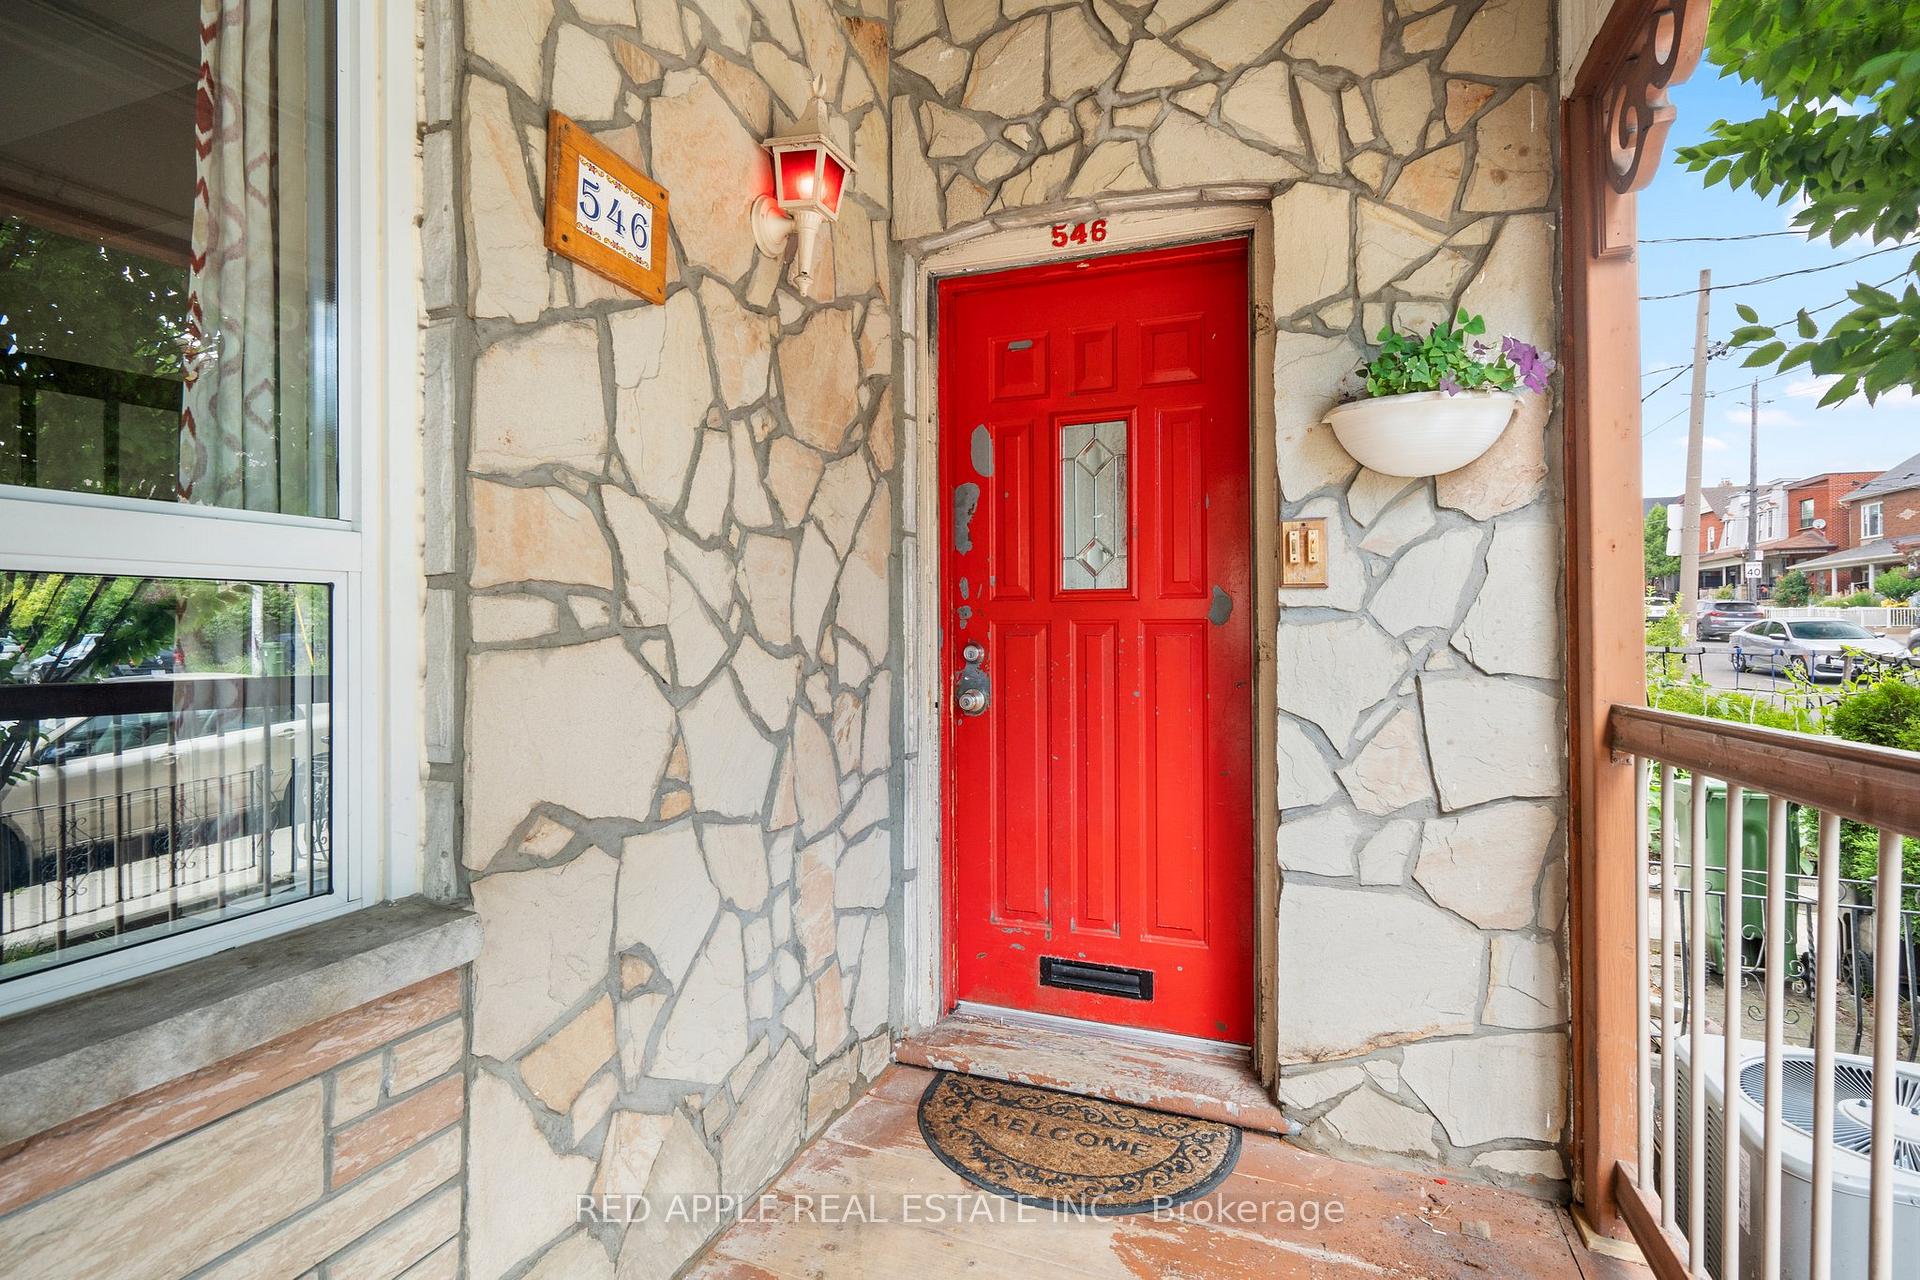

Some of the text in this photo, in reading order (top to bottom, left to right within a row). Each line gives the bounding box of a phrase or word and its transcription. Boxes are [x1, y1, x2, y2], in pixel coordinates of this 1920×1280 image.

[579, 177, 649, 250] 546
[1051, 218, 1107, 248] 546
[1747, 568, 1760, 576] 40
